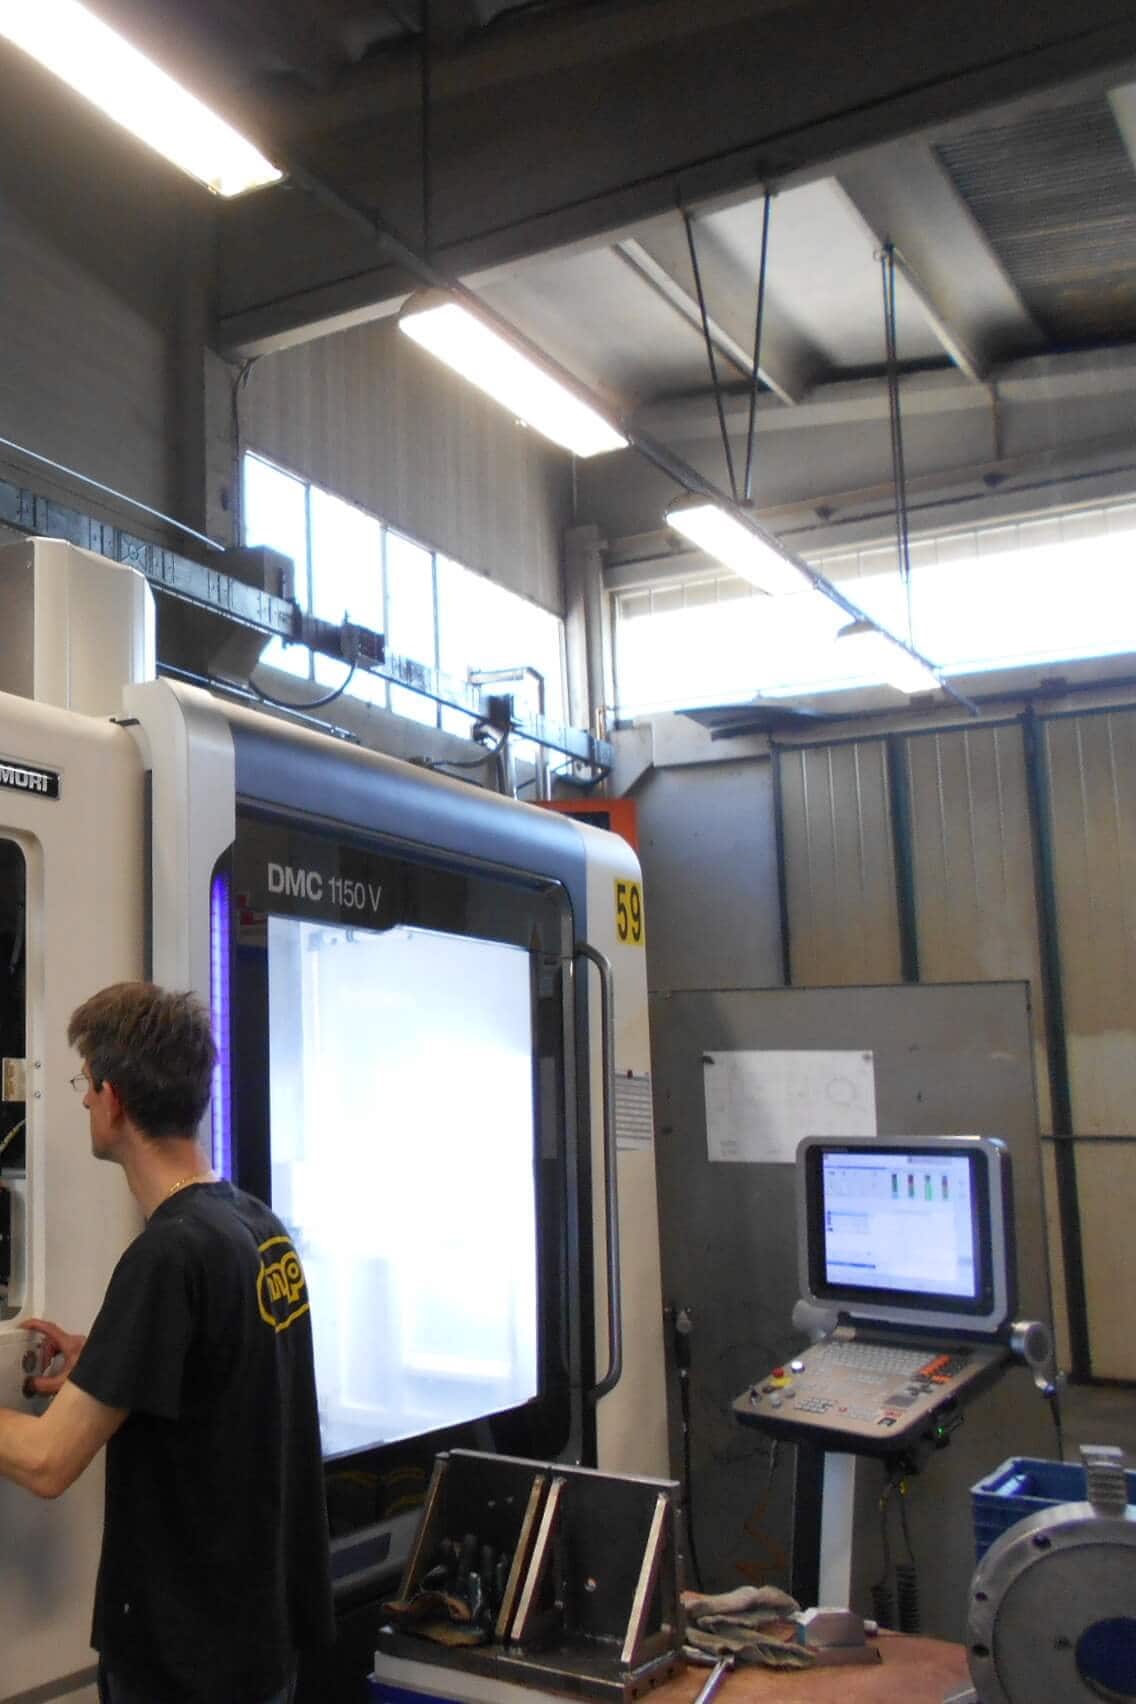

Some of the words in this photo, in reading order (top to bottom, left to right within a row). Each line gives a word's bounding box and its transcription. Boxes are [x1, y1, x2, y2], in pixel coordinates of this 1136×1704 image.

[267, 862, 323, 900] DMC
[327, 876, 366, 910] 1150
[368, 883, 383, 912] V
[616, 884, 641, 942] 59
